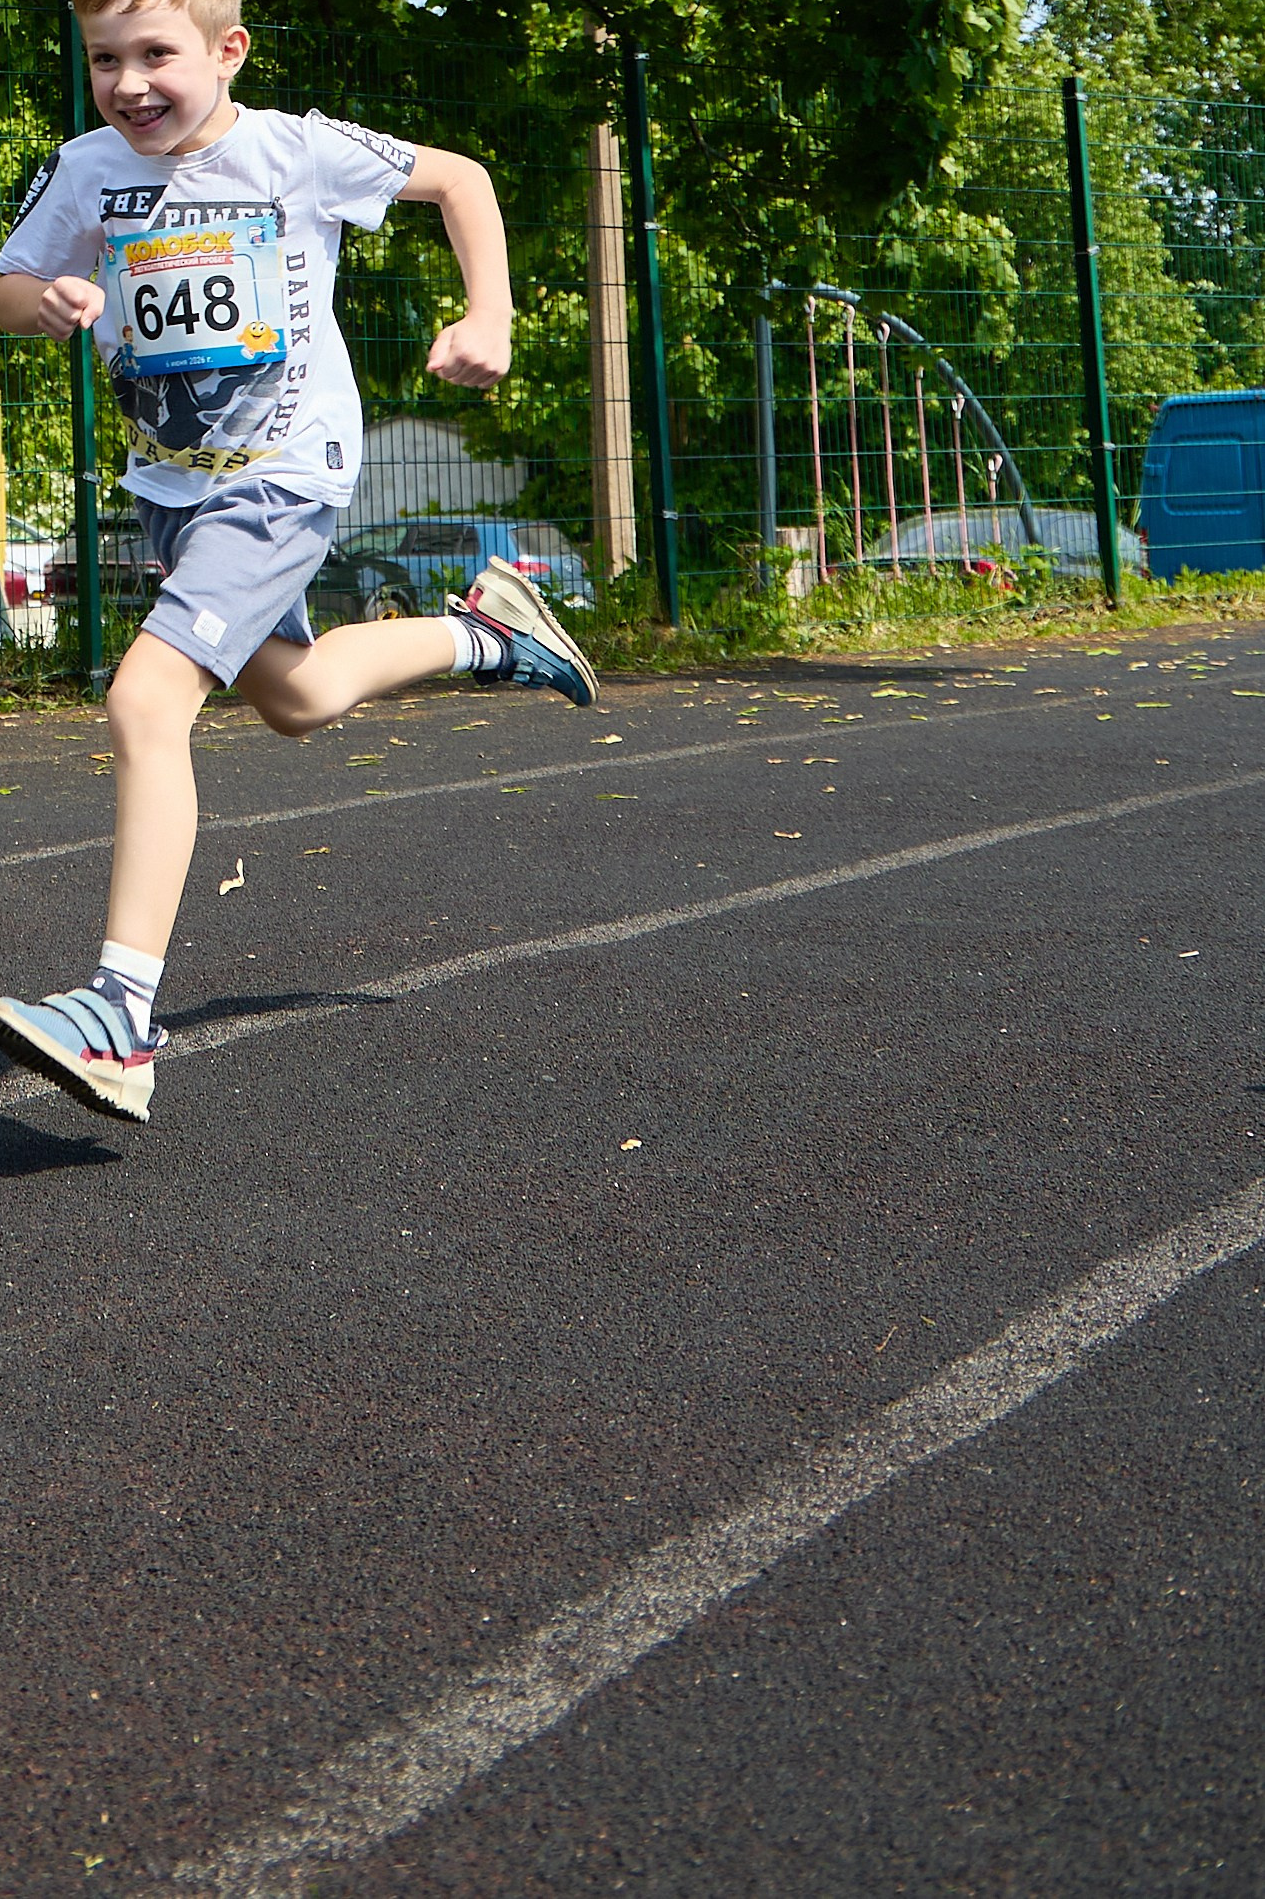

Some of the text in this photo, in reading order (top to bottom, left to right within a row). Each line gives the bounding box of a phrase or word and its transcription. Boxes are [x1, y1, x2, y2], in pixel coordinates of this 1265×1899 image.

[98, 191, 152, 216] THE
[124, 231, 235, 266] КОЛОБОК
[134, 274, 240, 341] 648
[266, 251, 311, 441] DARK SIDE
